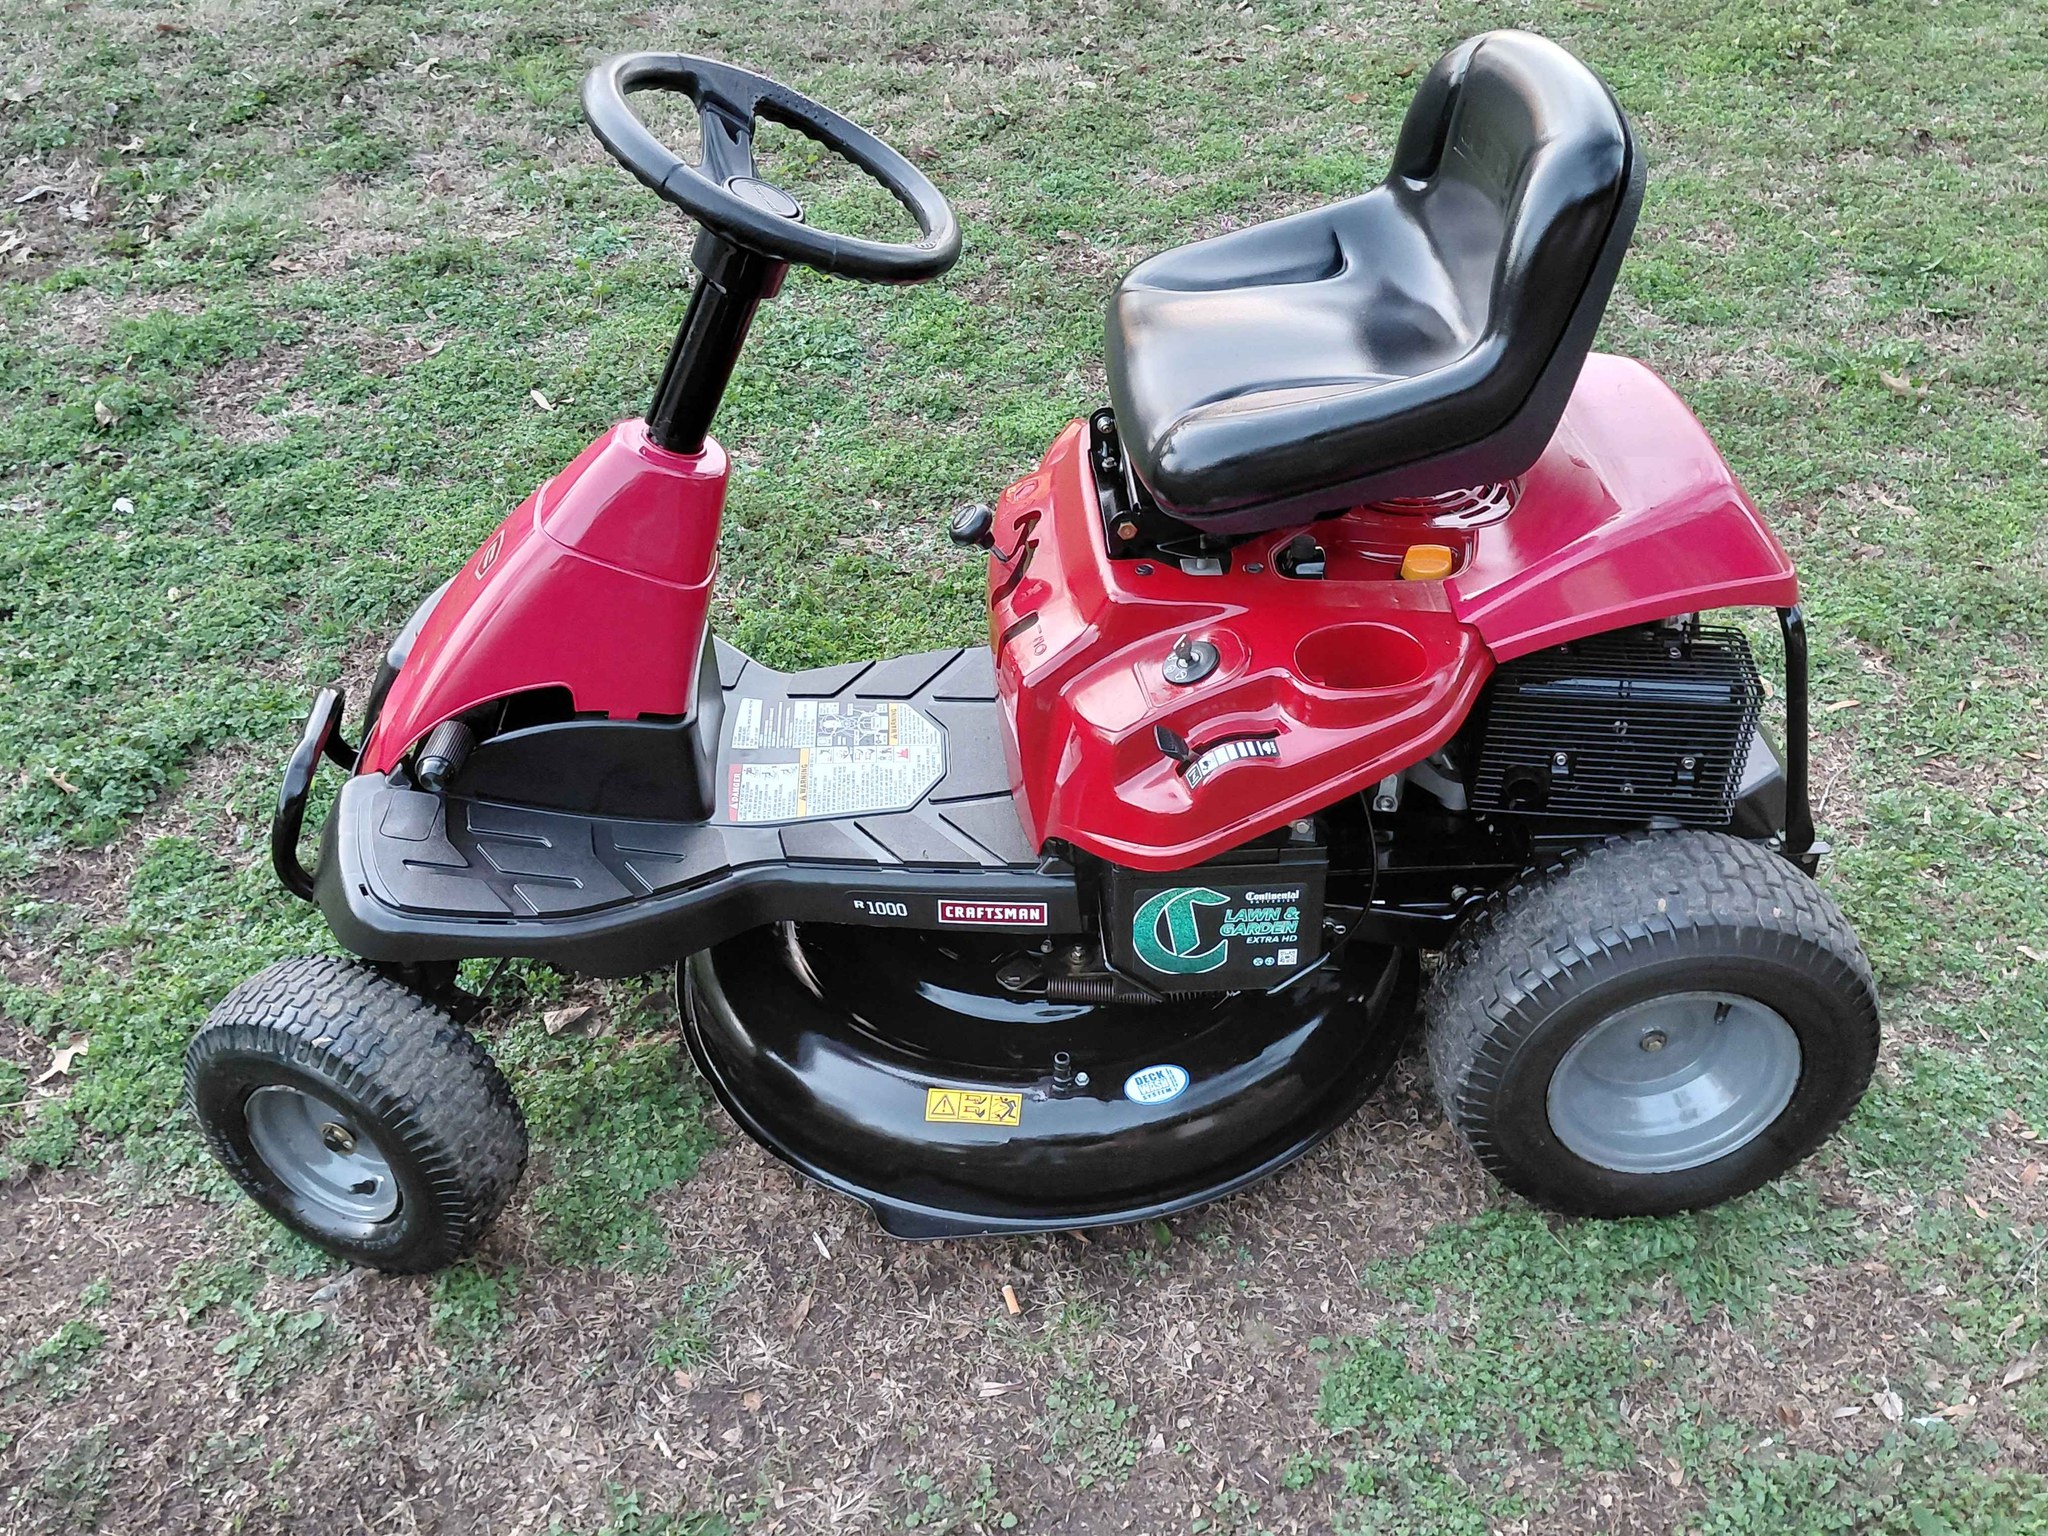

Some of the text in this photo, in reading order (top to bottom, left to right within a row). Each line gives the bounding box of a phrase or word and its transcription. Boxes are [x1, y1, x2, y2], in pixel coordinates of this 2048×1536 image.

[799, 763, 808, 794] WARNING
[731, 773, 741, 802] DANGER
[1245, 889, 1300, 901] Continental
[945, 906, 1040, 920] CRAFTSMAN
[1224, 906, 1300, 923] LAWN &
[1219, 920, 1299, 937] GARDEN
[1246, 934, 1298, 944] EXTRA HD
[1135, 1070, 1164, 1085] DECK
[1138, 1078, 1170, 1095] WASH
[1142, 1088, 1171, 1100] SYSTEM
